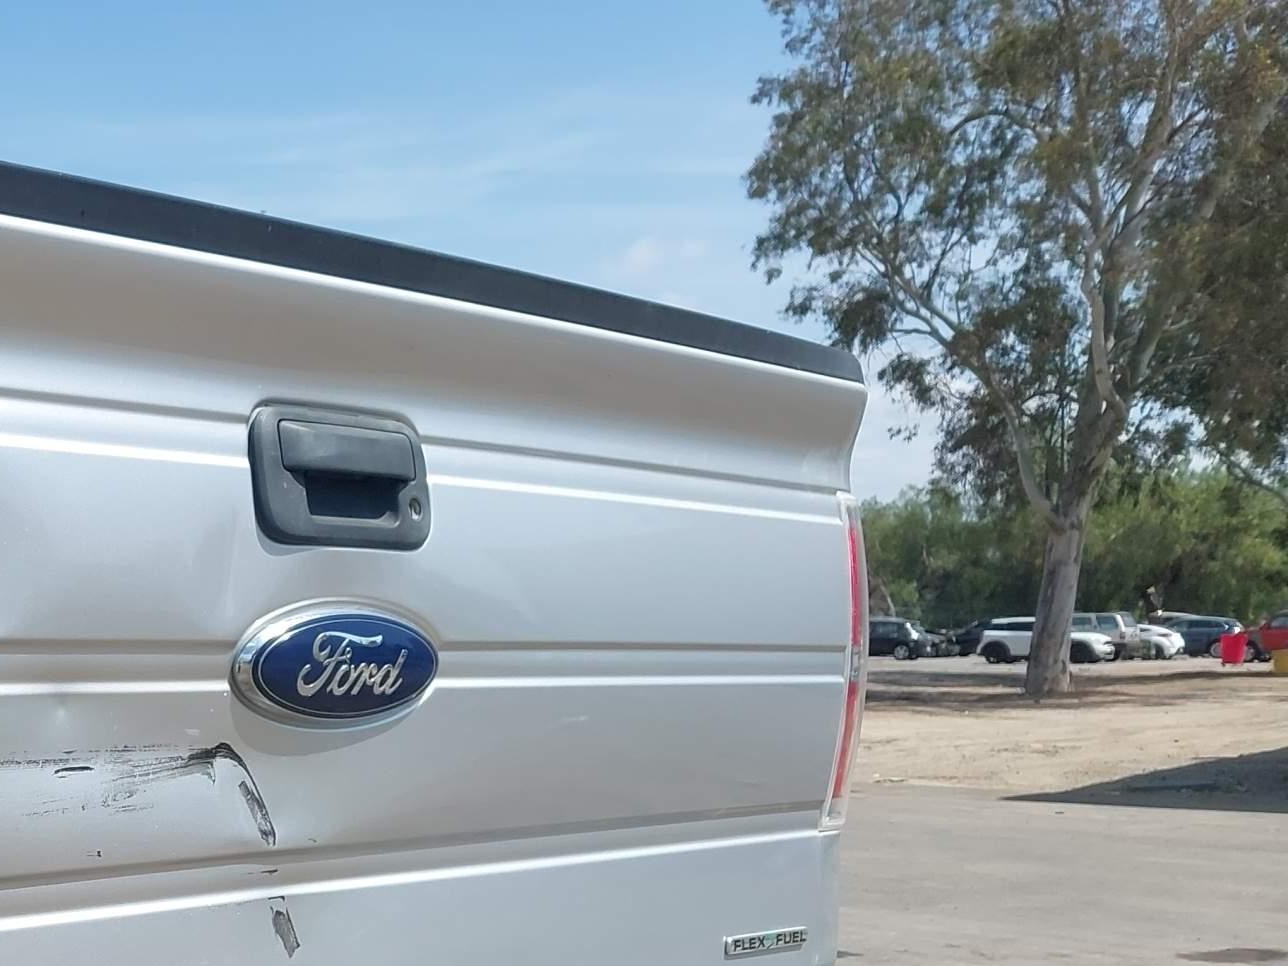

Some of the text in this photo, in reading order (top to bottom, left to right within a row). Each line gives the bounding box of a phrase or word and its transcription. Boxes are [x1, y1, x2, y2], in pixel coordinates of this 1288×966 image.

[296, 630, 409, 697] Ford
[733, 930, 807, 952] FLEX FUEL
